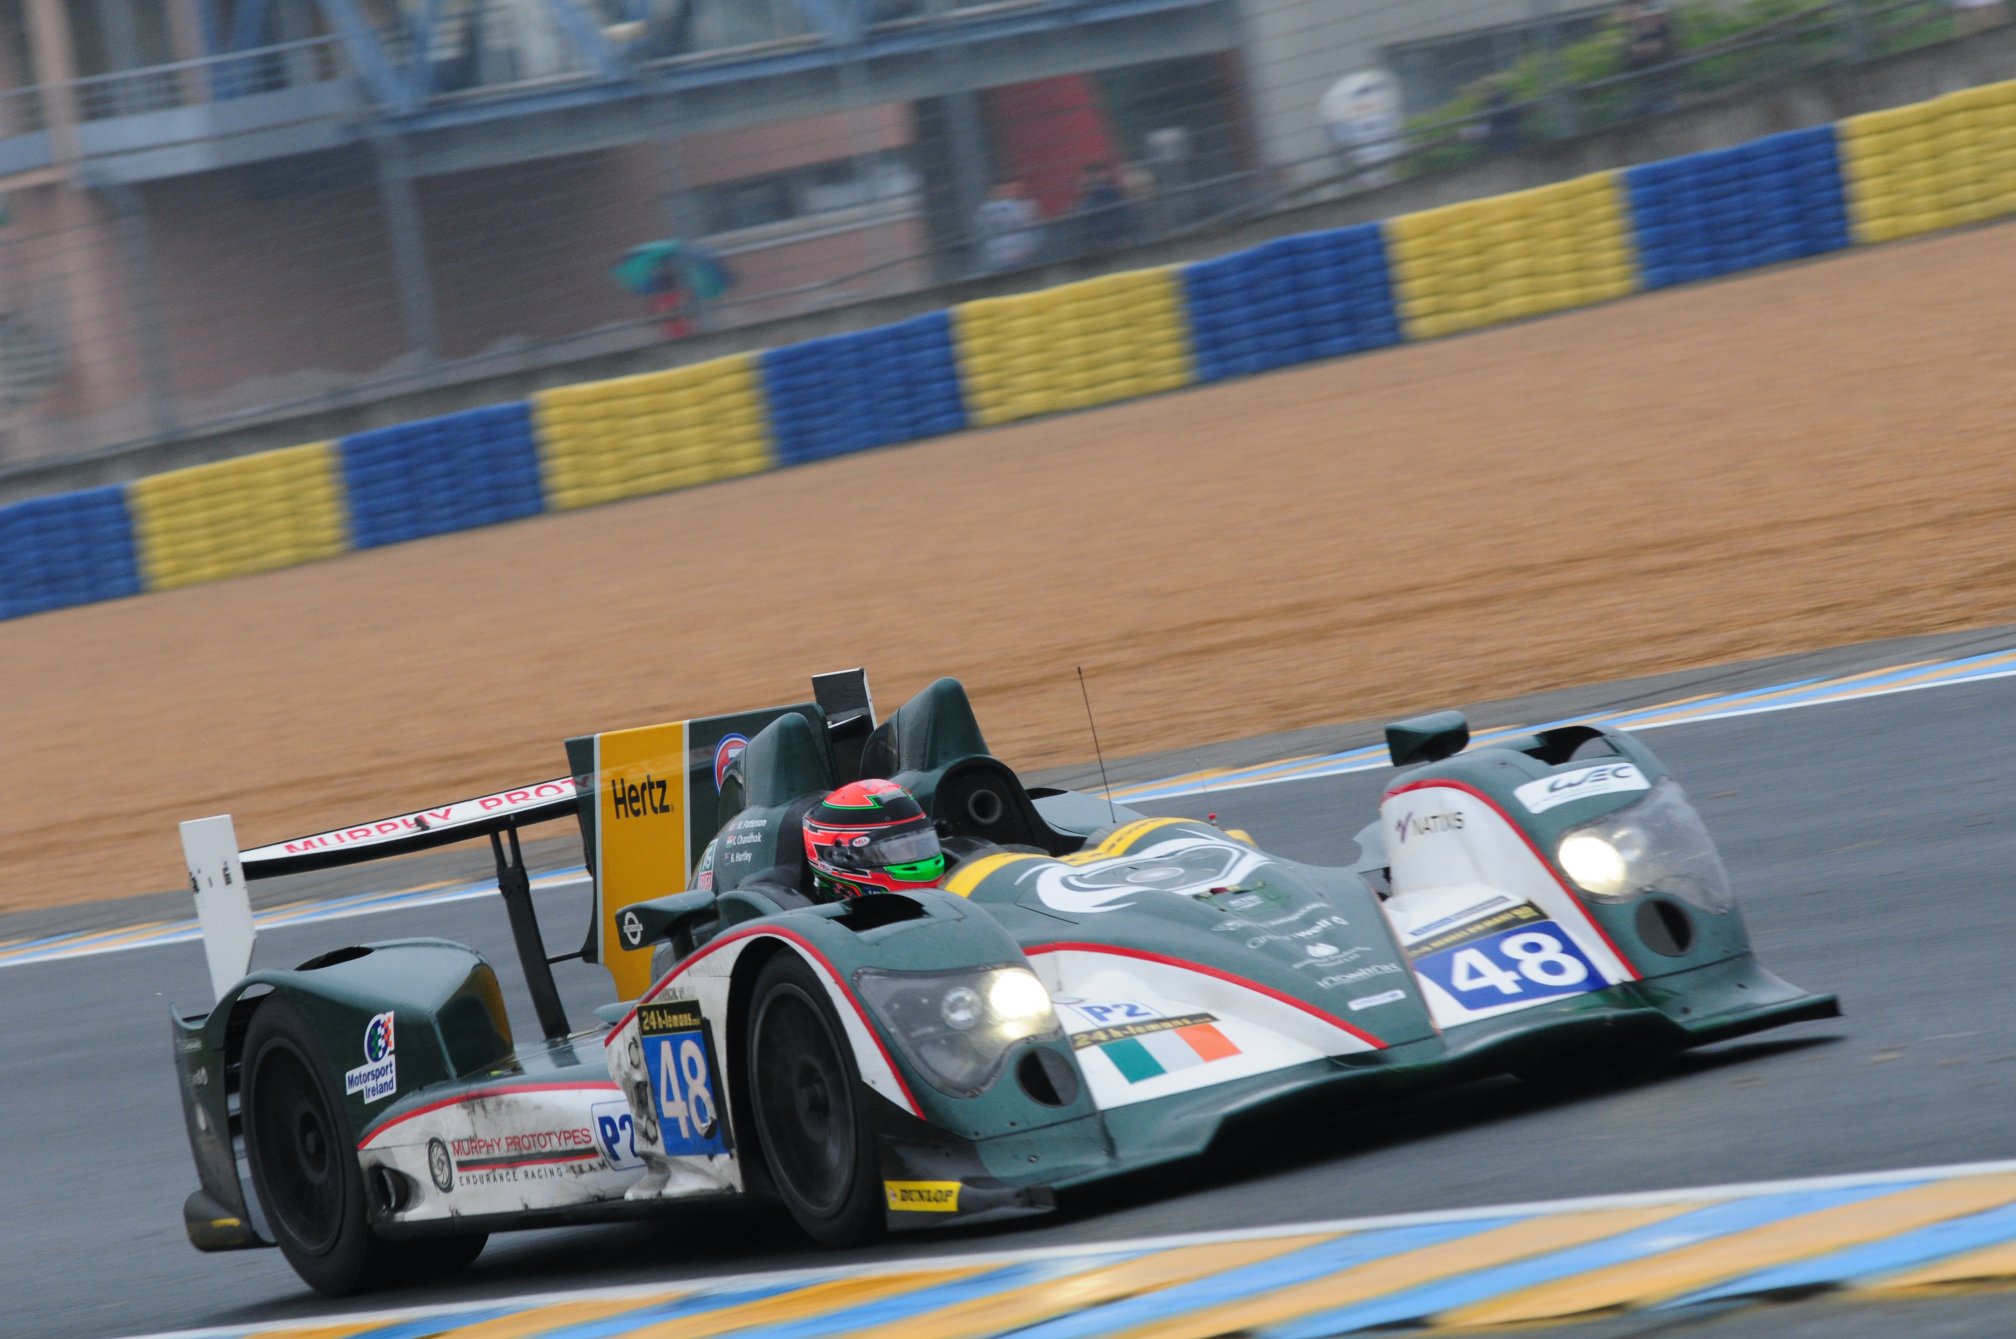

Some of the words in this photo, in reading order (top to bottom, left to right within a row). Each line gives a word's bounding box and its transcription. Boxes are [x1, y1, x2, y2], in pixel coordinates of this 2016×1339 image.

[1549, 765, 1632, 792] WEC
[611, 774, 670, 819] Hertz
[284, 808, 451, 853] MURPHY
[1452, 932, 1588, 995] 48
[1080, 1003, 1152, 1022] P2
[347, 1060, 394, 1090] Motorsport
[365, 1075, 395, 1099] Ireland
[660, 1039, 717, 1139] 48
[452, 1136, 502, 1158] MURPHY
[505, 1128, 593, 1151] PROTOTYPES
[597, 1114, 640, 1161] P2
[459, 1169, 519, 1187] ENDURANCE
[524, 1166, 563, 1182] RACING
[900, 1189, 954, 1203] DUNLOP
